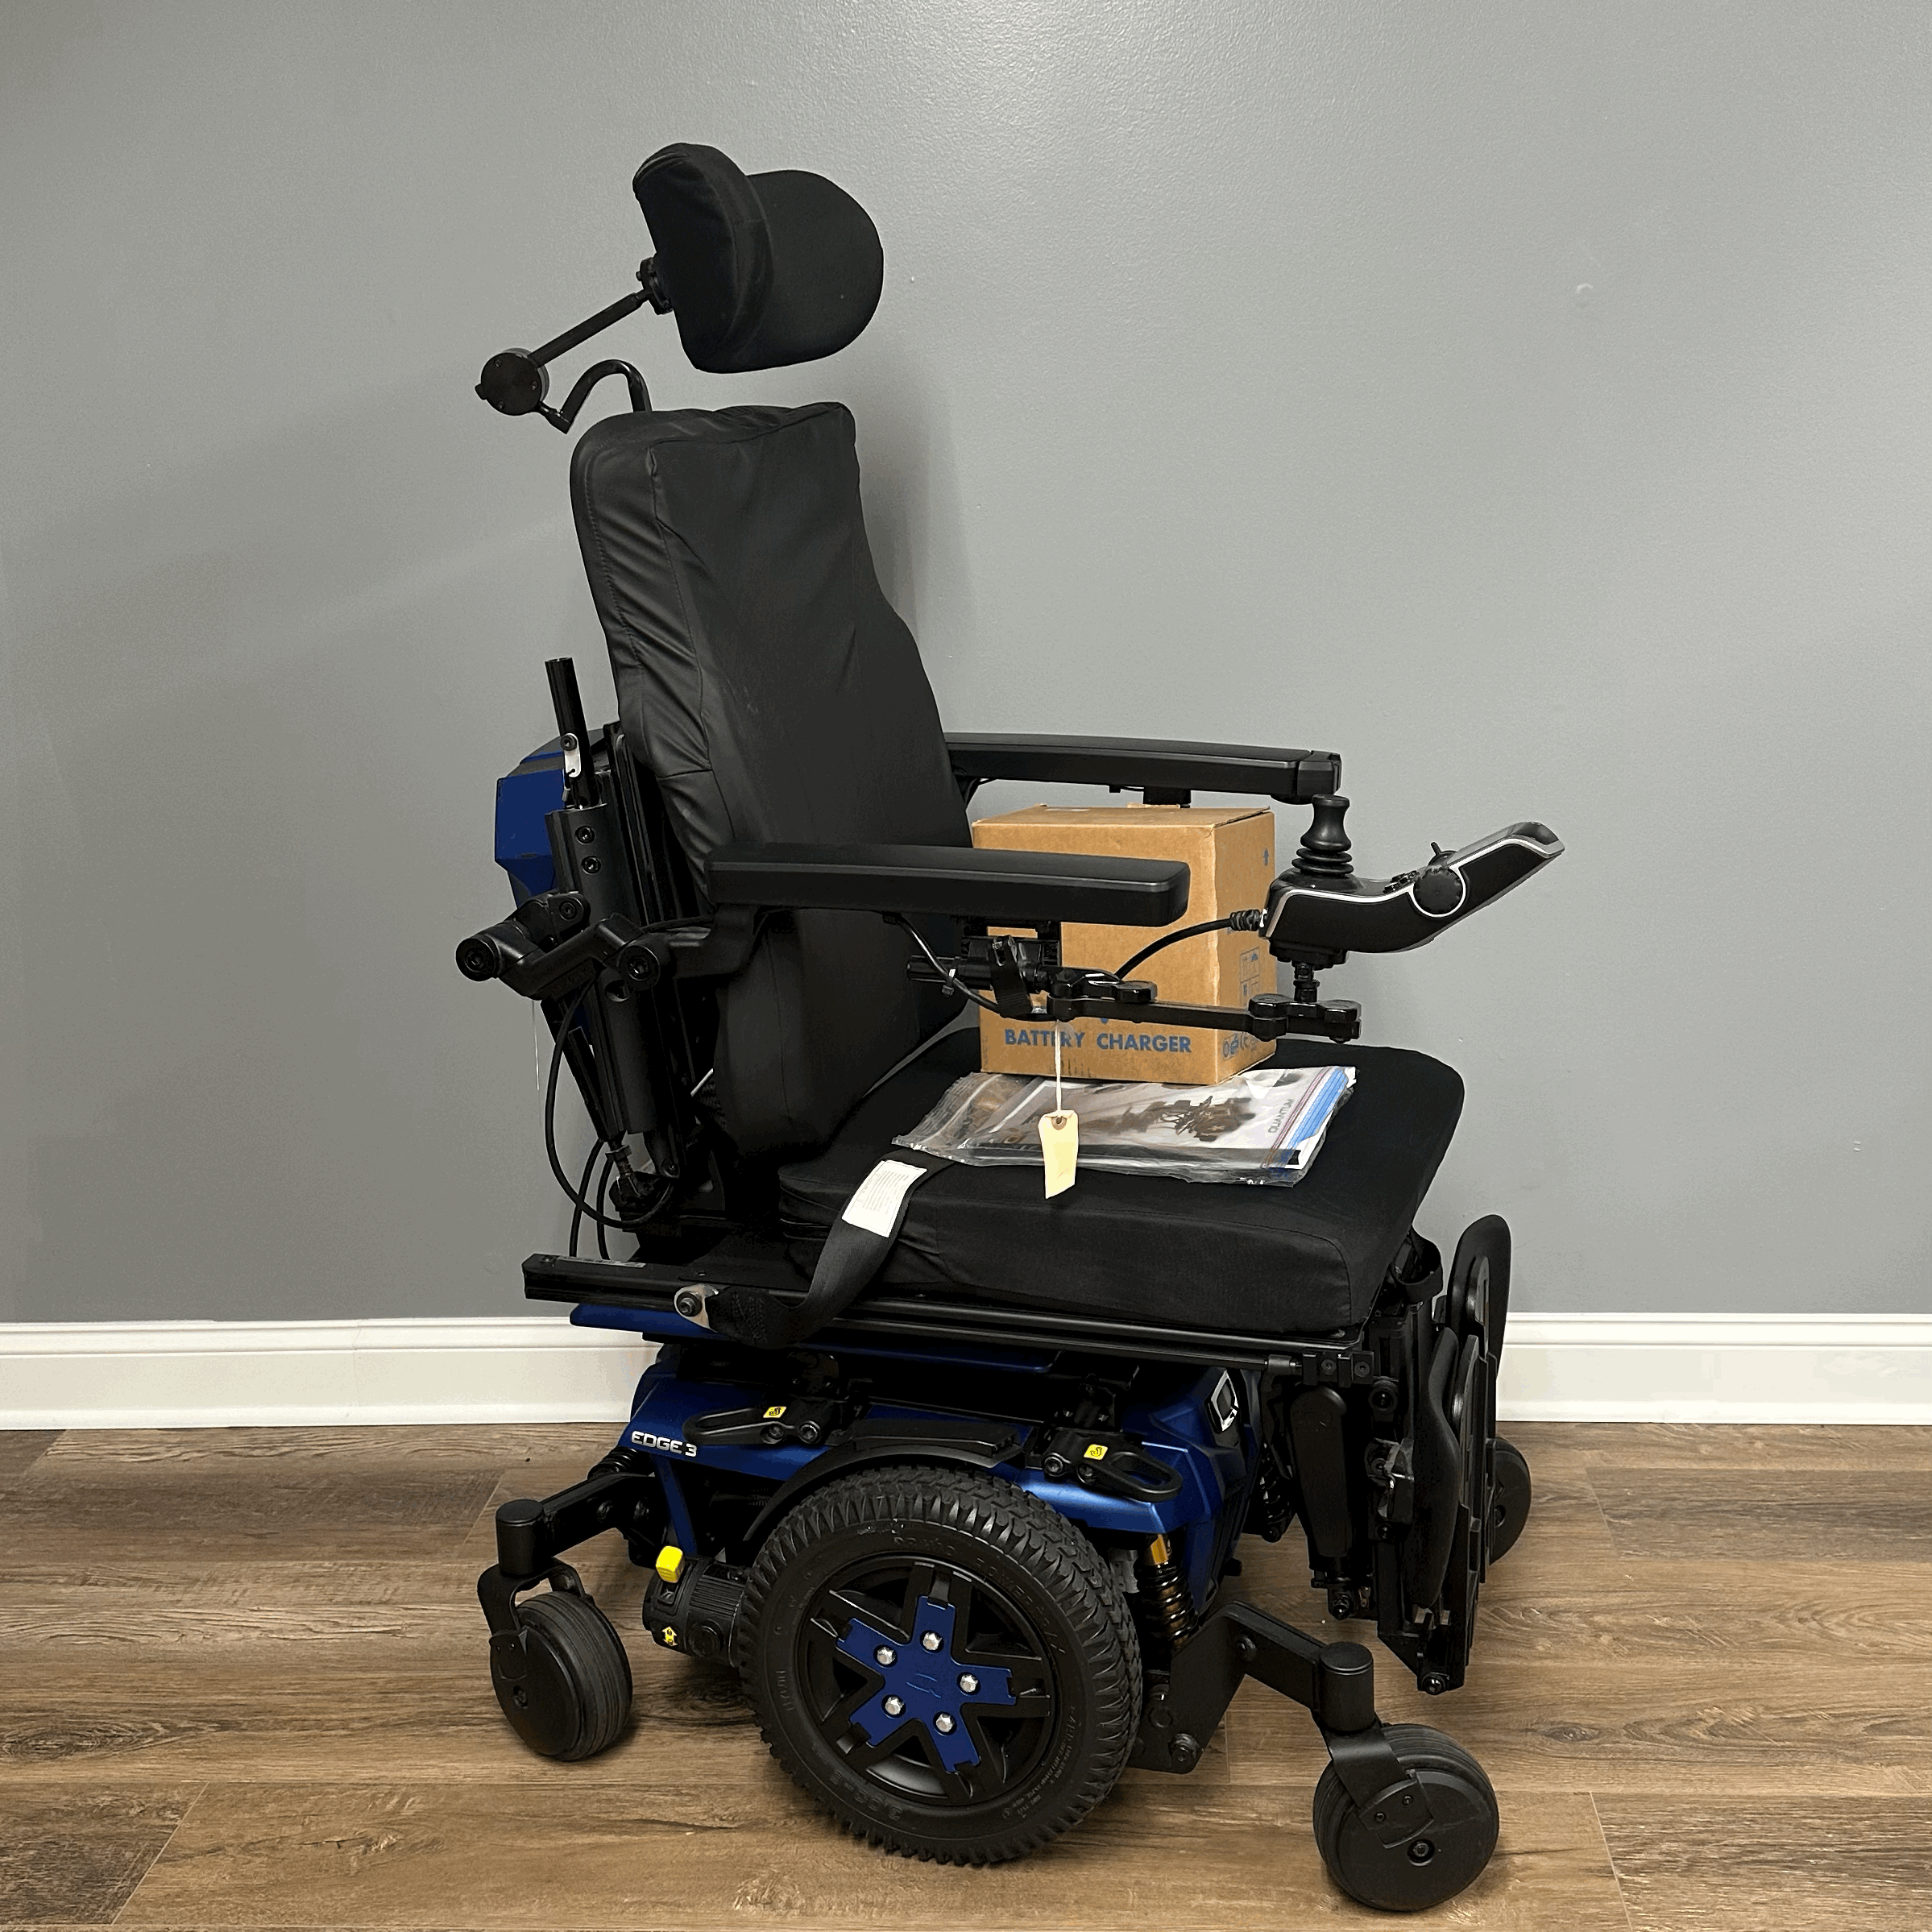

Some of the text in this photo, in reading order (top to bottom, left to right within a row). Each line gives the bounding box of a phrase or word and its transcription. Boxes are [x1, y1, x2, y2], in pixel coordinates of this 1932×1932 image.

[1097, 1033, 1192, 1053] CHARGER
[631, 1430, 698, 1457] EDGE 3
